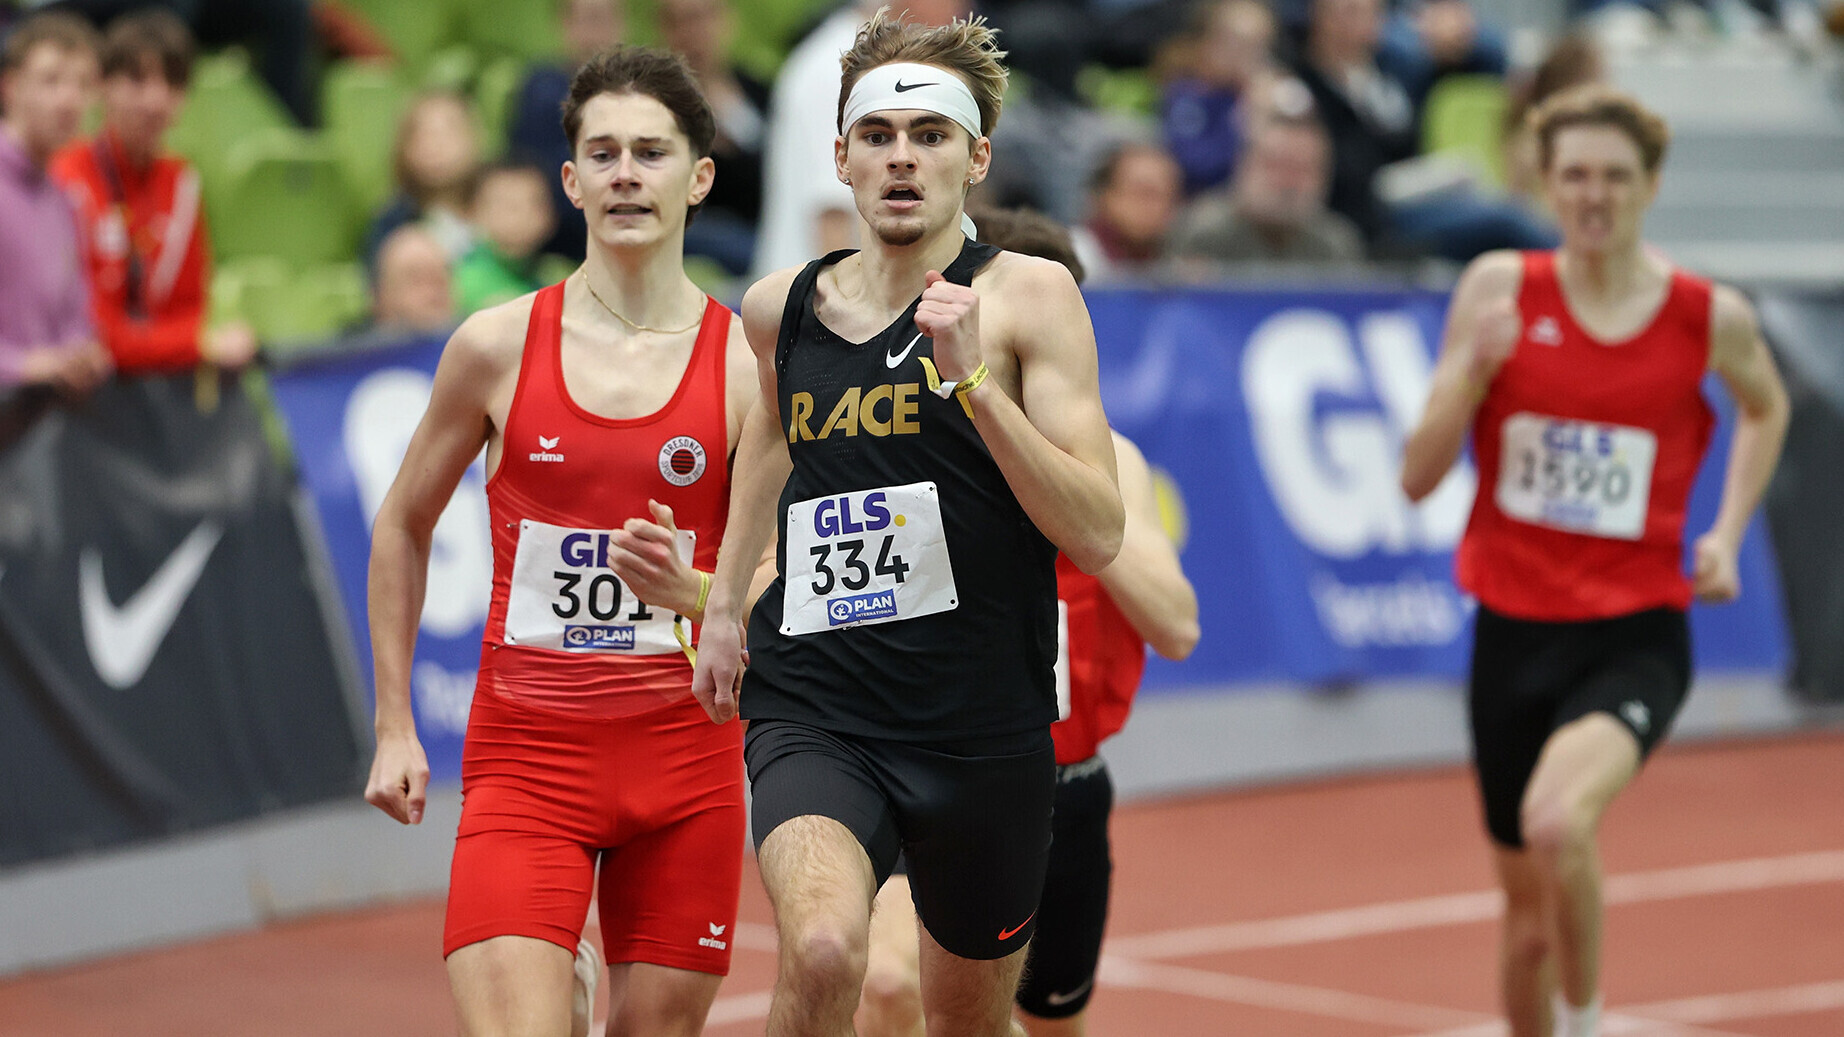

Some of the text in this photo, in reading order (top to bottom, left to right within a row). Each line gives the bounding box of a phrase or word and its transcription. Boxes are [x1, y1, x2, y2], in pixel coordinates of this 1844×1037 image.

[789, 383, 920, 443] RACE
[1241, 309, 1477, 559] GL
[663, 438, 704, 457] DRESDNER
[529, 451, 564, 462] erima
[809, 535, 909, 595] 334
[854, 595, 893, 612] PLAN
[855, 608, 894, 617] INTERNATIONAL
[593, 629, 633, 641] PLAN
[698, 937, 727, 950] erima
